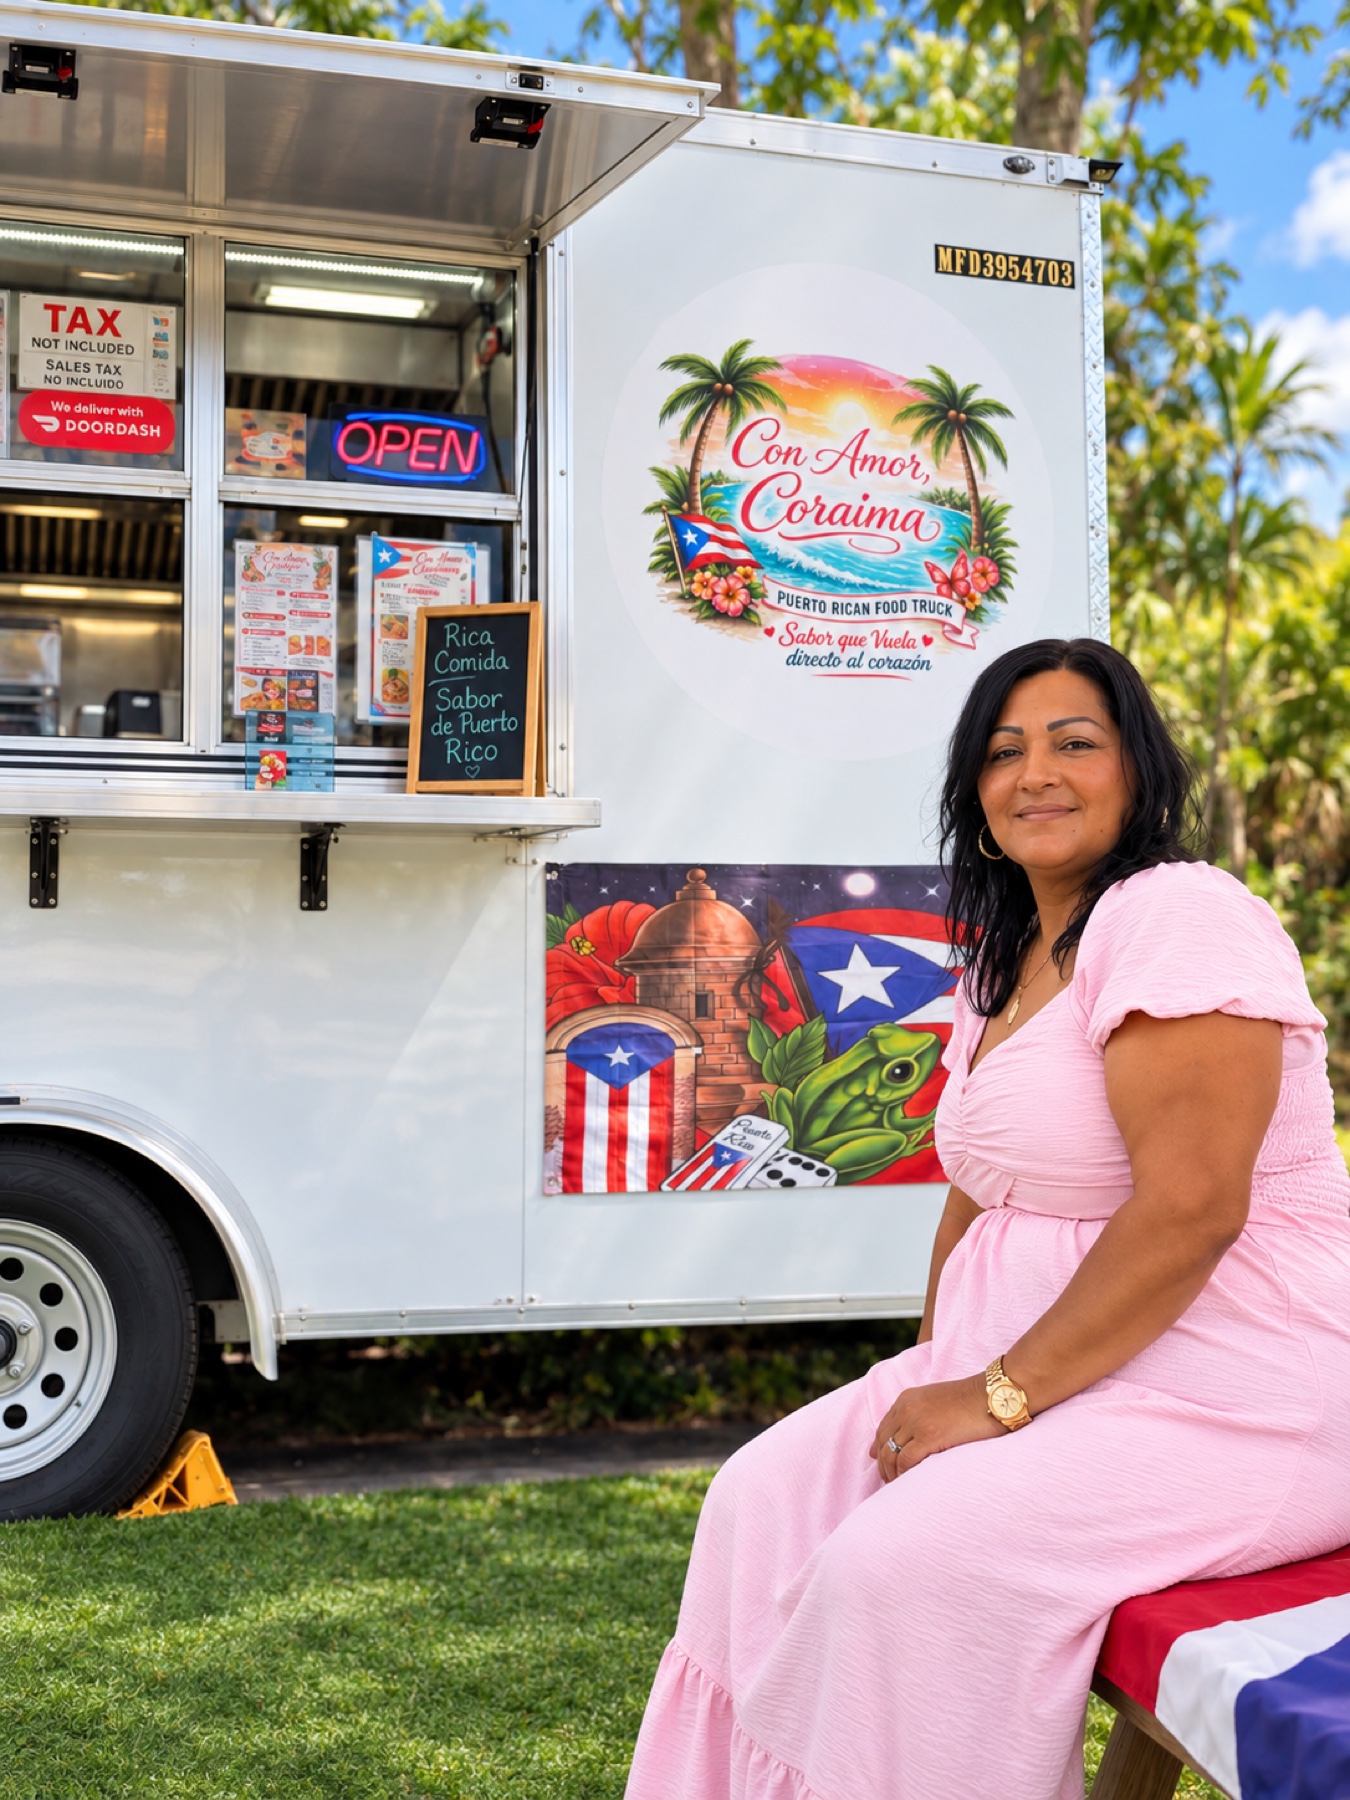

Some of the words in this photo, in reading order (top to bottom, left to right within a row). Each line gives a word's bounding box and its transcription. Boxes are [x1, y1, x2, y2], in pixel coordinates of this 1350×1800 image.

[936, 246, 1073, 286] MFD3954703
[43, 303, 122, 338] TAX
[31, 337, 60, 349] NOT
[65, 339, 135, 355] INCLUDED
[46, 359, 91, 373] SALES
[95, 363, 122, 375] TAX
[43, 375, 62, 385] NO
[66, 376, 124, 389] INCLUIDO
[50, 401, 71, 412] We
[74, 403, 116, 415] deliver
[117, 406, 144, 417] with
[65, 420, 161, 437] DOORDASH
[336, 421, 481, 474] OPEN
[731, 417, 808, 469] Con
[809, 428, 931, 485] Amor,
[740, 471, 941, 542] Coraima
[777, 590, 827, 615] PUERTO
[831, 600, 870, 617] RICAN
[874, 599, 908, 615] FOOD
[911, 598, 953, 617] TRUCK
[443, 622, 495, 648] Rica
[778, 622, 835, 648] Sabor
[838, 631, 867, 653] que
[870, 629, 918, 650] Vuela
[434, 649, 510, 675] Comida
[785, 648, 842, 669] directo
[846, 649, 865, 669] al
[868, 651, 932, 672] corazón
[435, 686, 503, 712] Sabor
[430, 715, 453, 736] de
[458, 709, 519, 736] Puerto
[444, 737, 498, 764] Rico
